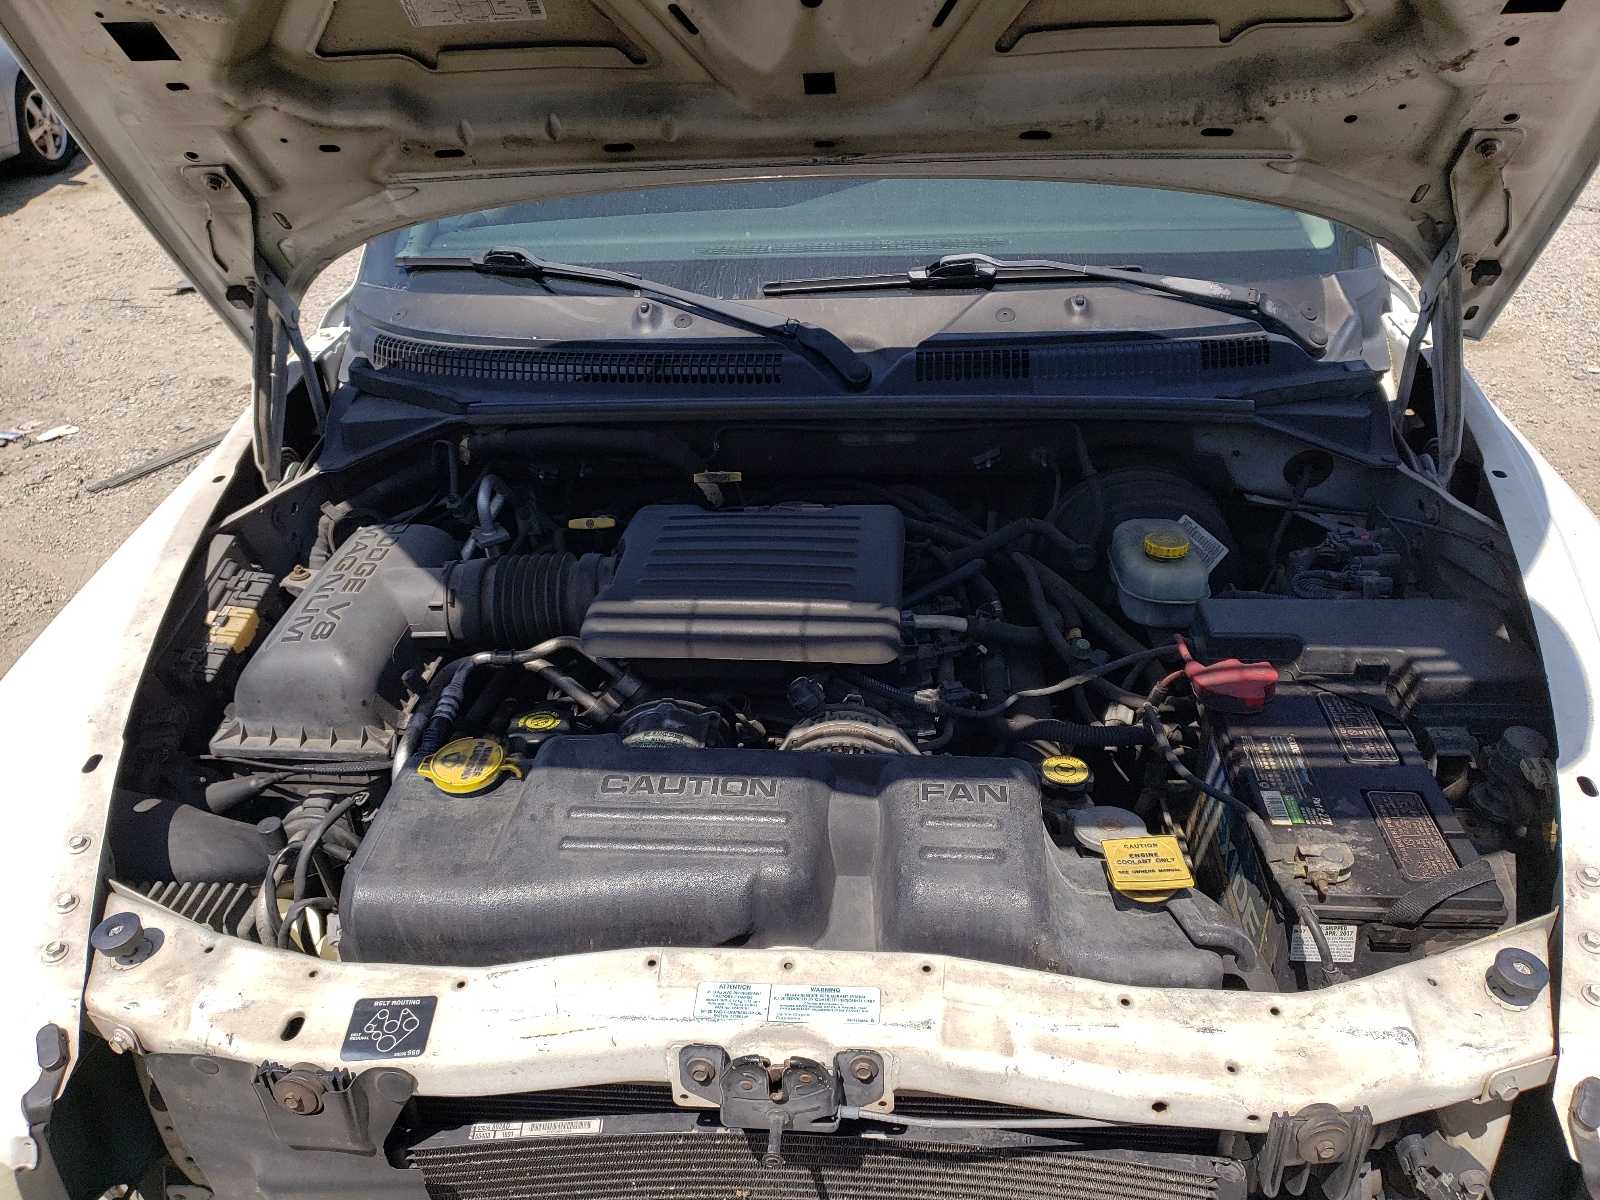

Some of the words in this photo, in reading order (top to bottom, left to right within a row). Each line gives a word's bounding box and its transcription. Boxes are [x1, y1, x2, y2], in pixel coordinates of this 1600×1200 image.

[281, 528, 379, 643] MAGNUM
[341, 524, 409, 593] DODGE
[310, 602, 351, 641] V8
[600, 774, 778, 797] CAUTION
[920, 783, 1009, 803] FAN
